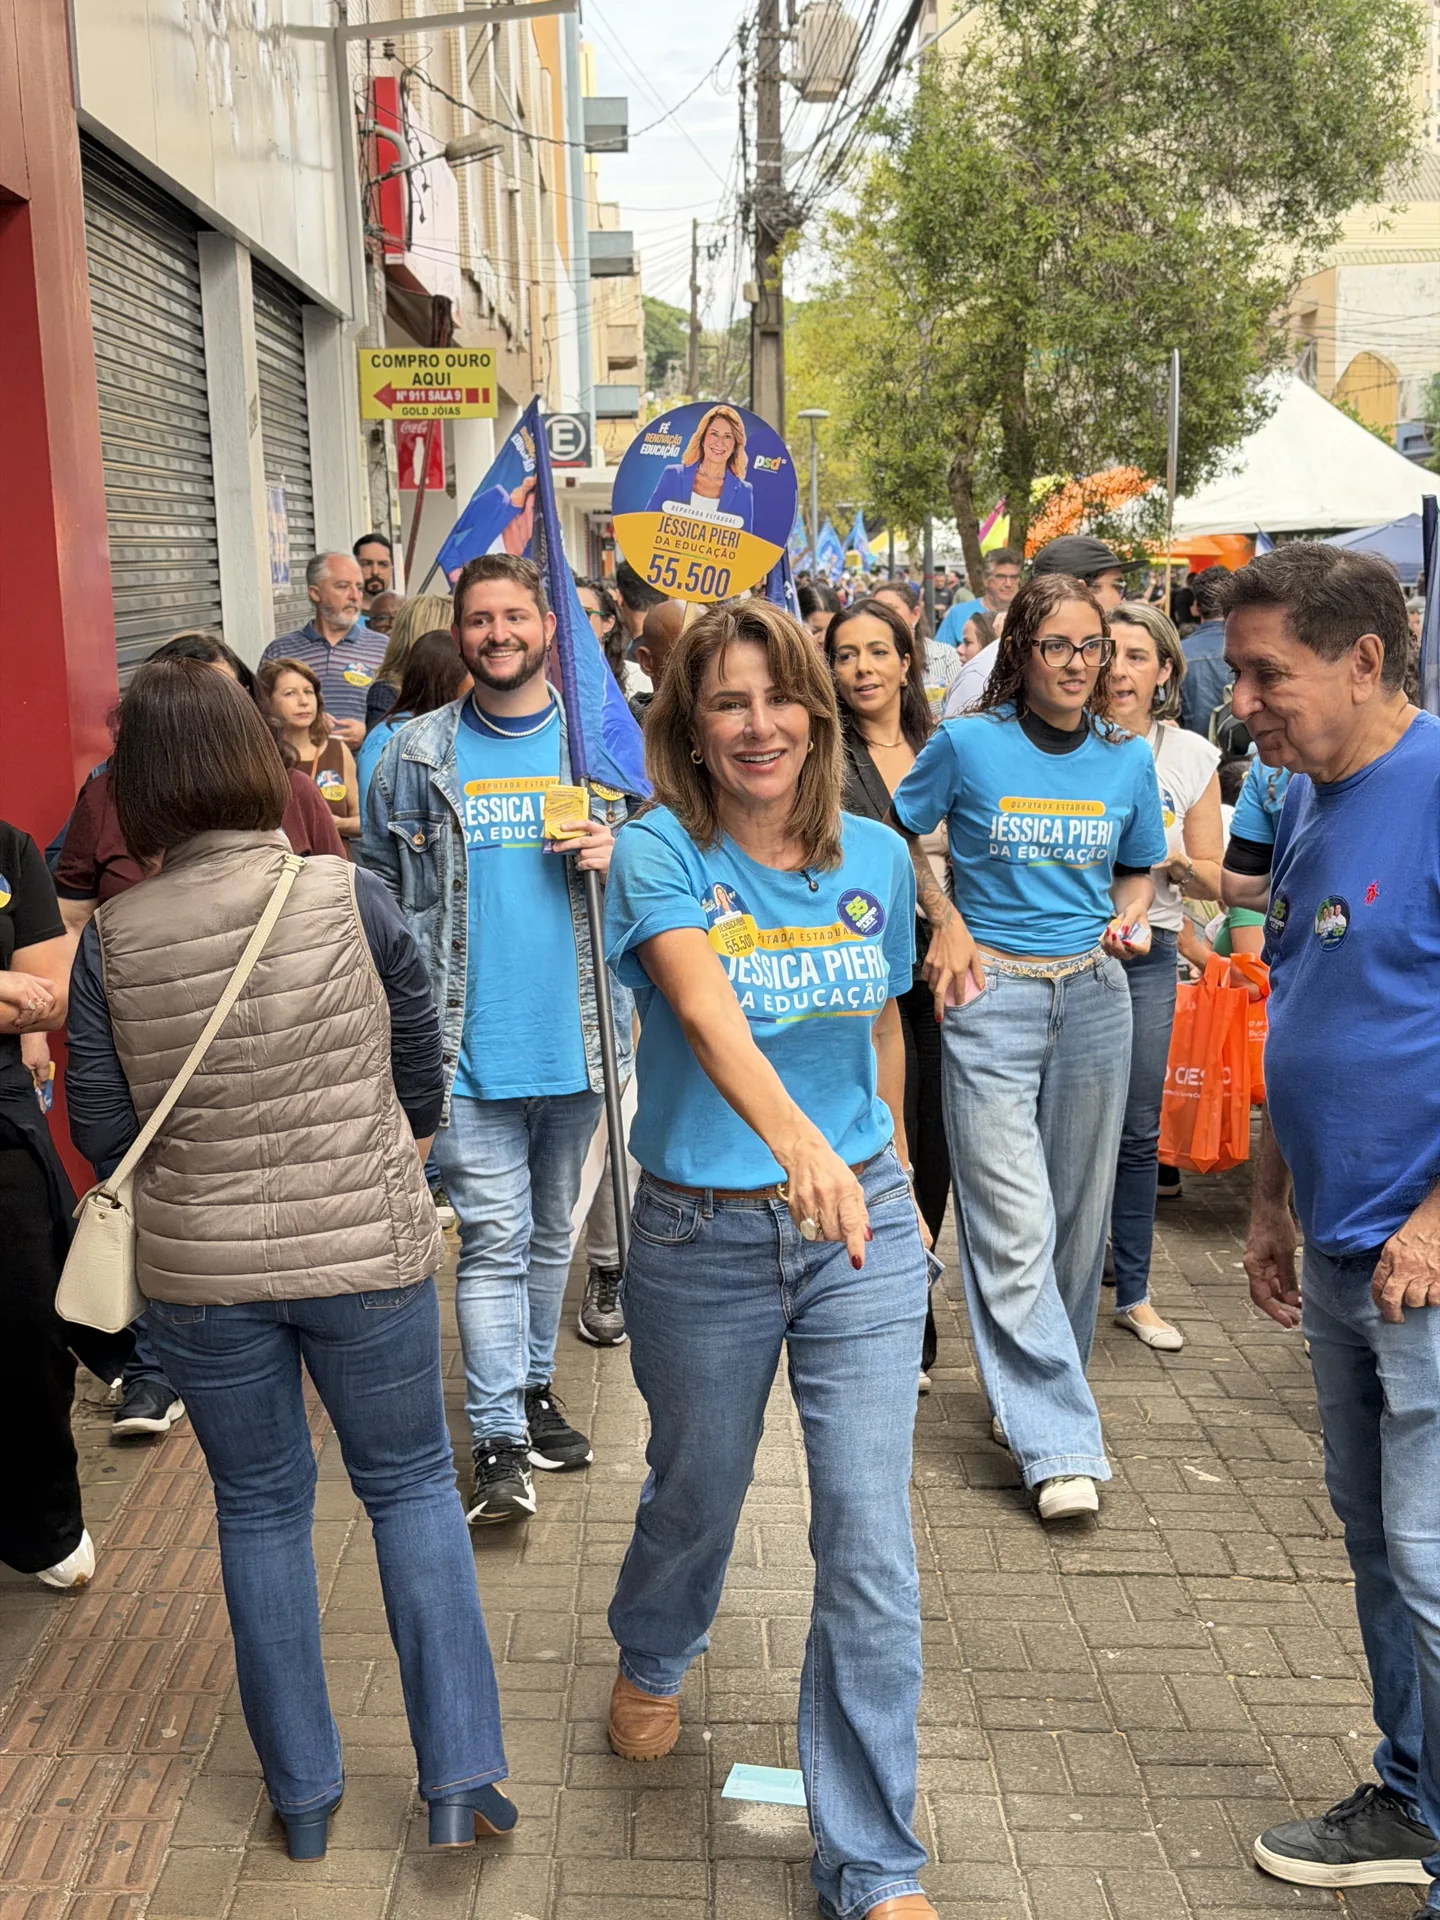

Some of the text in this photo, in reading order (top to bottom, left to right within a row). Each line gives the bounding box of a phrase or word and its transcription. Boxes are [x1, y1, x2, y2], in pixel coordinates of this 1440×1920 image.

[371, 354, 491, 368] COMPRO OURO
[412, 372, 451, 386] AQUI
[408, 390, 426, 401] 911
[428, 390, 453, 401] SALA
[454, 390, 462, 401] 9
[402, 405, 461, 416] GOLD JÓIAS
[552, 422, 575, 452] E
[658, 421, 672, 434] FÉ
[640, 443, 681, 459] EDUCAÇÃO
[753, 455, 781, 471] psd
[671, 505, 736, 525] DEPUTADA ESTADUAL
[657, 514, 741, 549] JÉSSICA PIERI
[655, 536, 736, 560] DA EDUCAÇÃO
[647, 553, 731, 598] 55.500
[476, 782, 521, 791] DEPUTADA
[463, 795, 535, 826] ÉSSICA
[1011, 801, 1096, 812] DEPUTADA ESTADUAL
[989, 813, 1114, 845] JÉSSICA PIERI
[990, 842, 1108, 863] DA EDUCAÇÃO
[845, 895, 868, 921] 55
[724, 933, 755, 955] 55.500
[822, 944, 886, 982] PIERI
[763, 982, 886, 1013] EDUCAÇÃO
